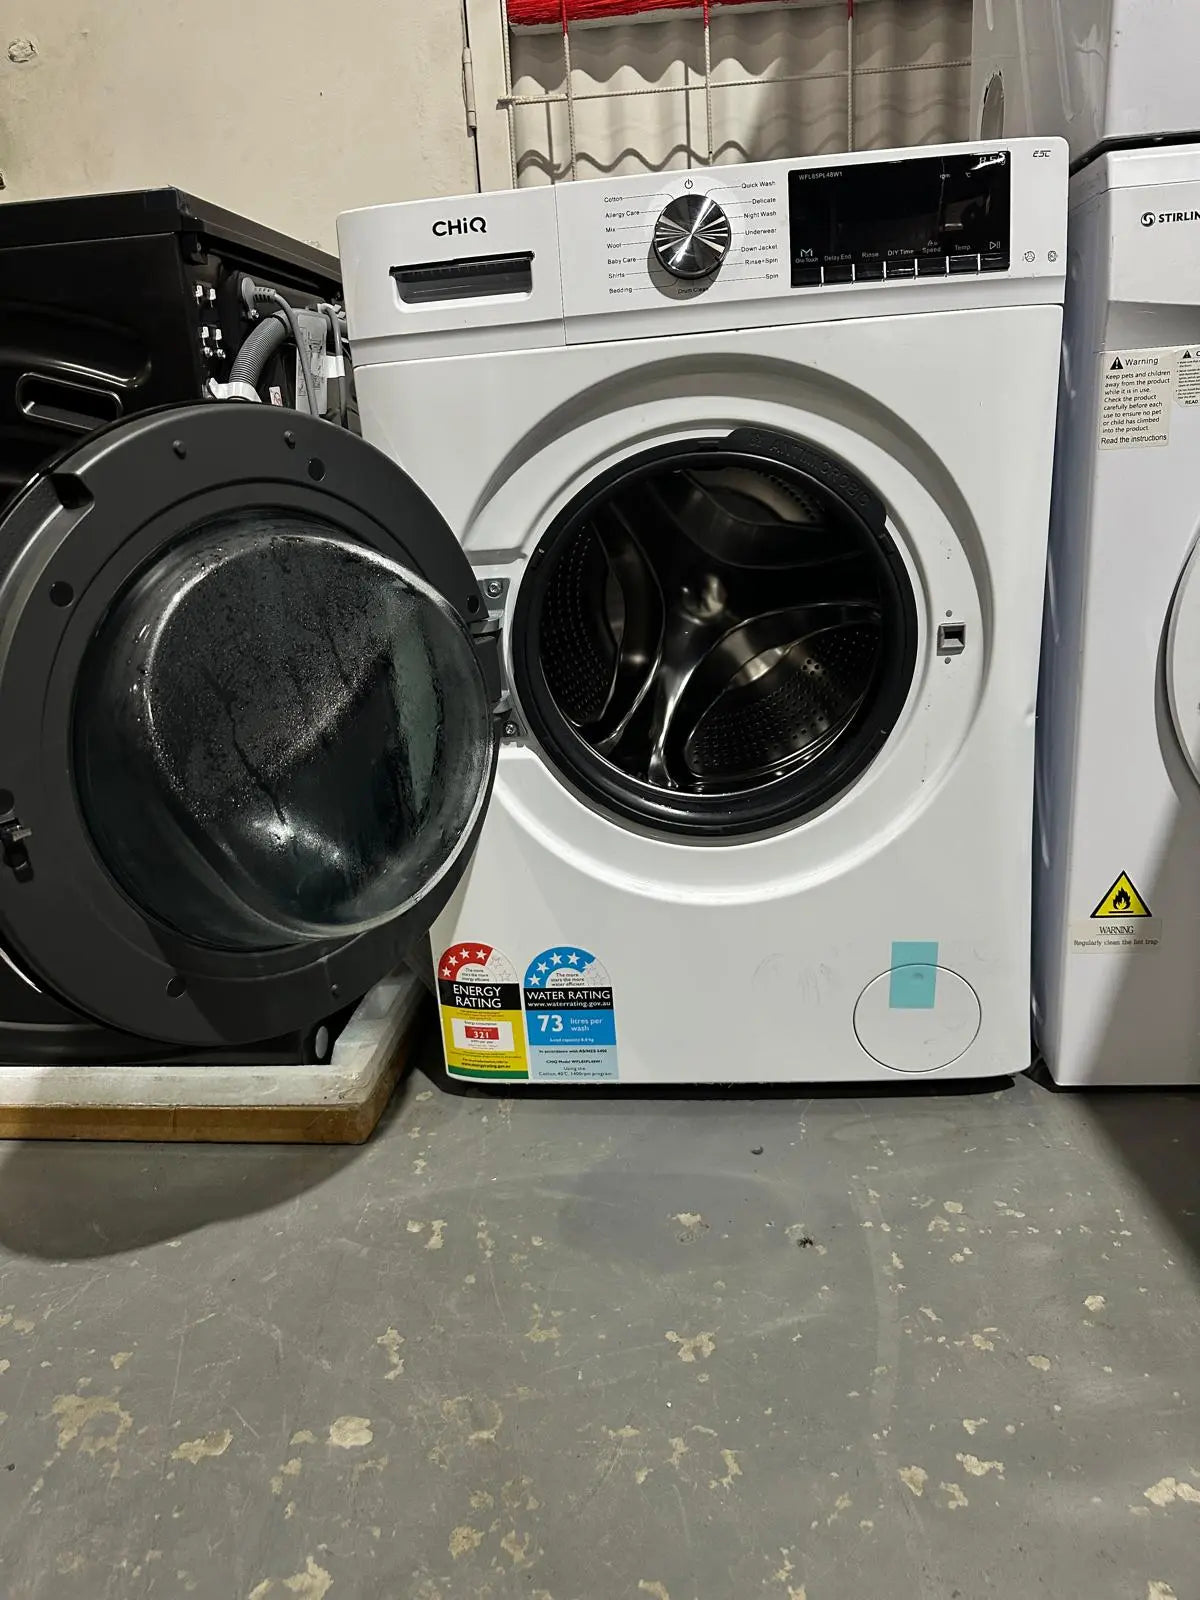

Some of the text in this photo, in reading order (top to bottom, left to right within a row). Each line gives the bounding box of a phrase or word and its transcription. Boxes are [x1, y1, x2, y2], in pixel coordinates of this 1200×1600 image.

[432, 216, 487, 236] CHiQ
[745, 228, 777, 236] Underwear
[922, 246, 942, 255] Speed
[1125, 358, 1159, 366] Warning
[1101, 437, 1118, 445] Read
[1130, 434, 1167, 443] instructions
[1099, 925, 1134, 934] WARNING
[1073, 939, 1102, 947] Regularly
[453, 984, 501, 997] ENERGY
[526, 990, 611, 1000] WATER RATING
[455, 995, 502, 1008] RATING
[537, 1014, 564, 1033] 73
[590, 1018, 602, 1026] per
[473, 1030, 489, 1039] 321
